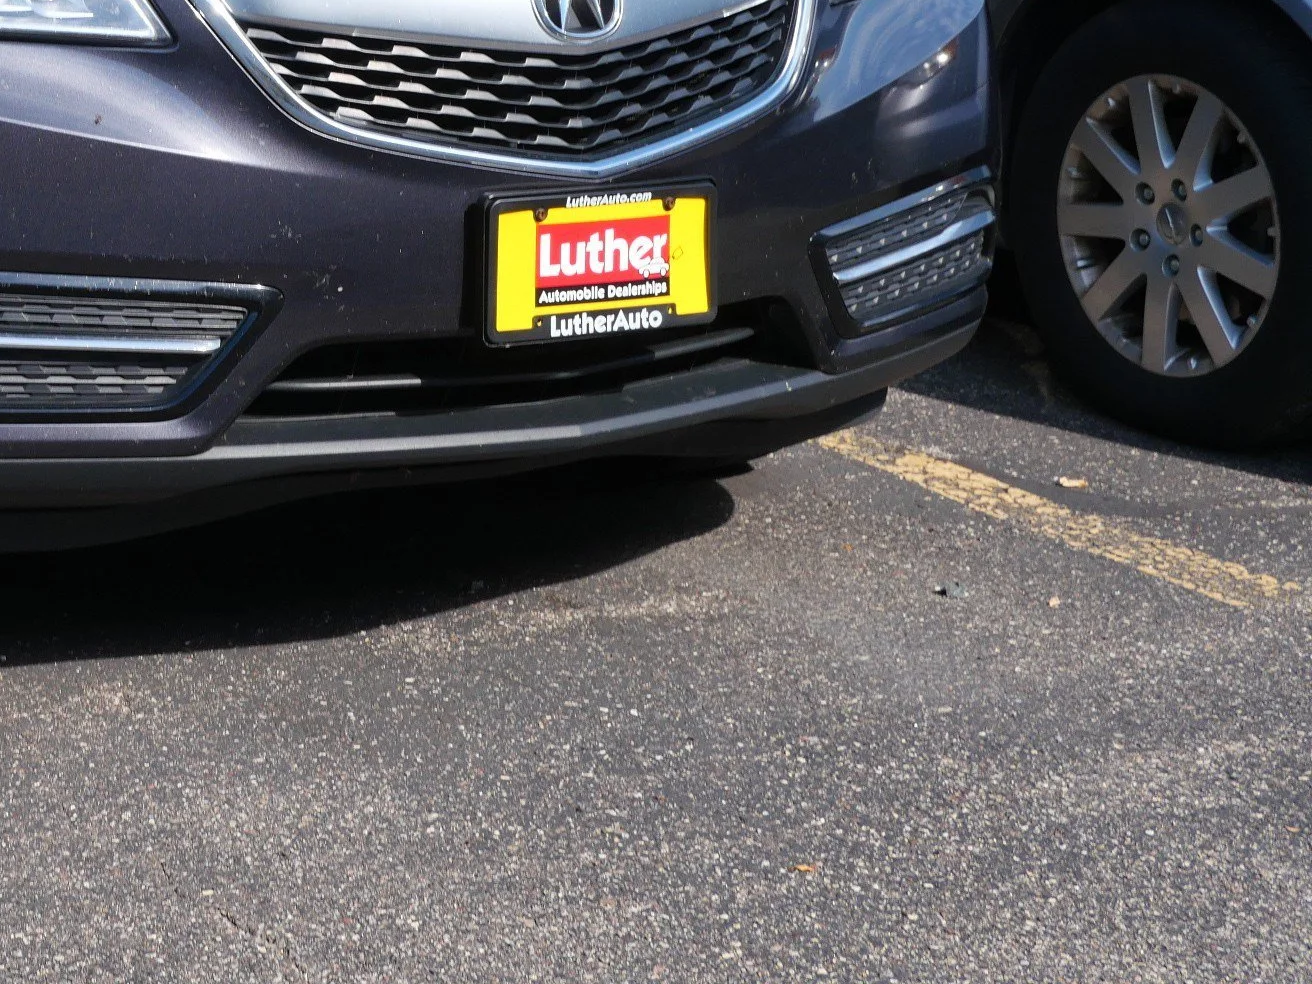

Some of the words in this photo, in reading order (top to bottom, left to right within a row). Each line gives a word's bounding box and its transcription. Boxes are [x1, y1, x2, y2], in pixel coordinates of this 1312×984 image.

[566, 192, 651, 208] LutherAuto.com
[539, 228, 668, 277] Luther
[538, 287, 605, 304] Automobile
[607, 280, 667, 298] Dealerships
[550, 309, 662, 337] LutherAuto
